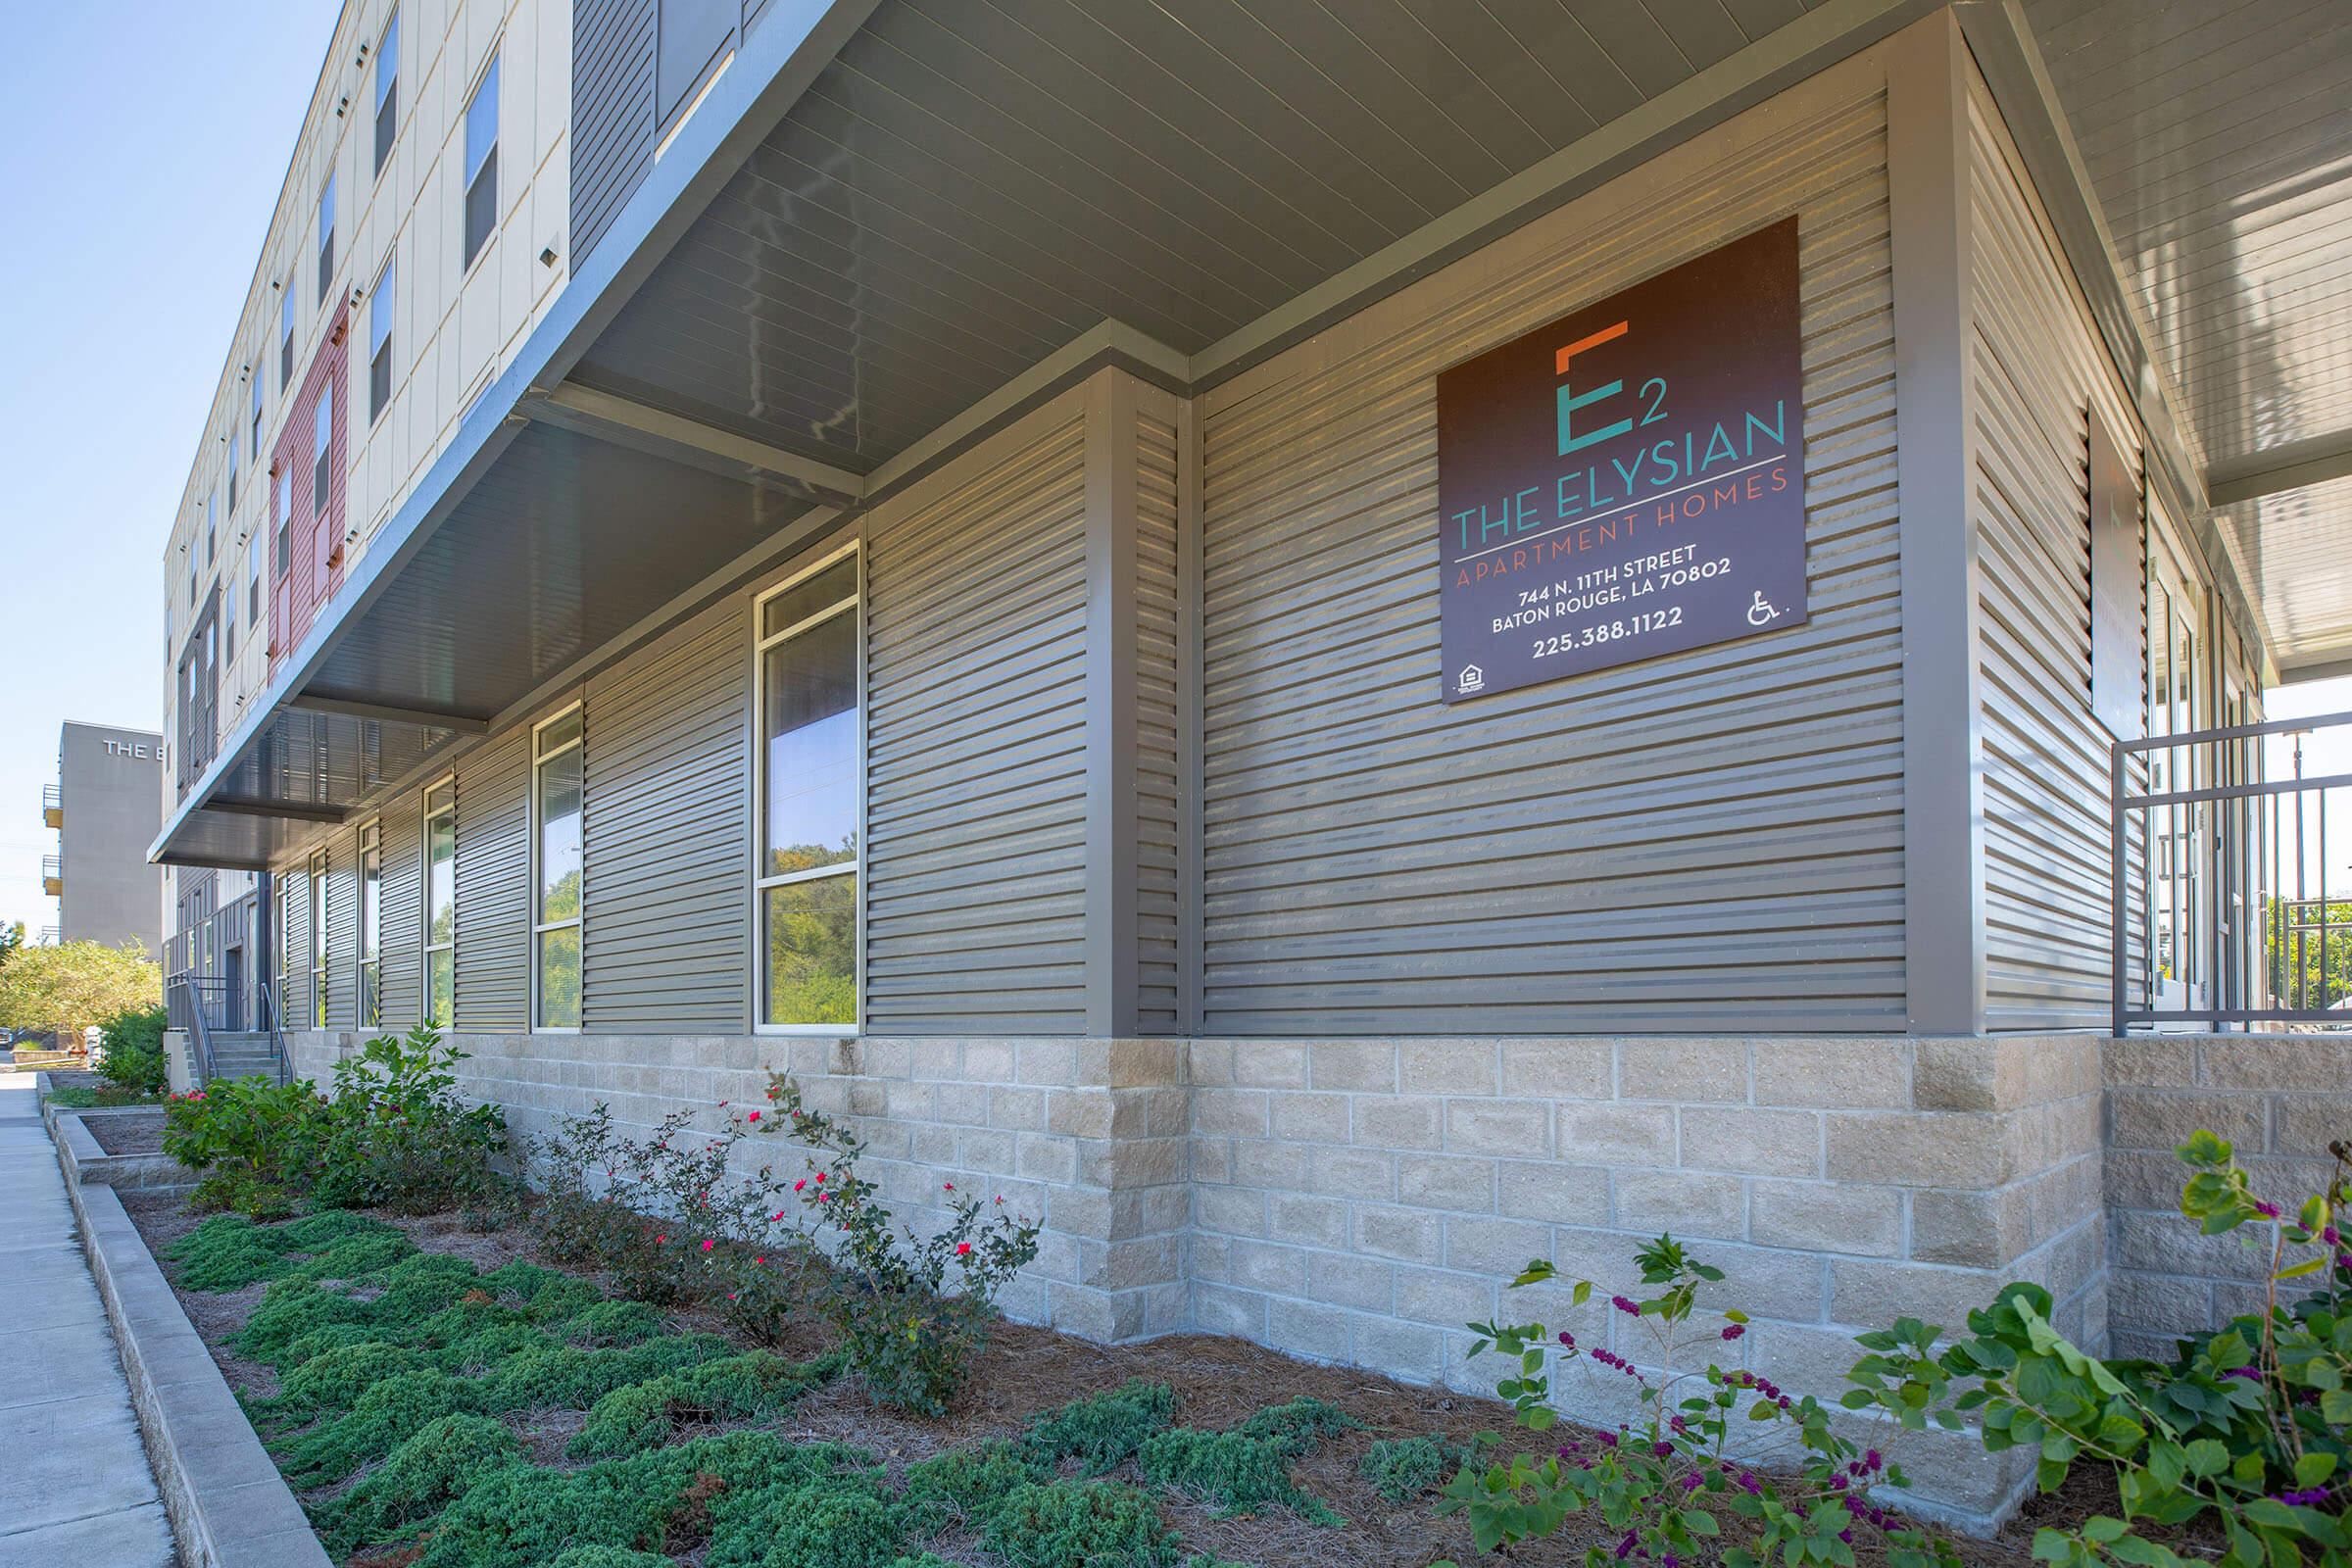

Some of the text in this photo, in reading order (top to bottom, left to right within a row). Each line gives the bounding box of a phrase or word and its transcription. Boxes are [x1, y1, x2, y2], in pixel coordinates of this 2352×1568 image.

[1451, 400, 1786, 550] THE ELYSIAN
[1456, 467, 1788, 588] APARTMENT HOMES
[1493, 558, 1732, 633] BATON ROUGE, LA 70802
[1519, 543, 1697, 607] 744 N. 11TH STREET
[1533, 606, 1684, 659] 225.388.1122
[102, 739, 148, 760] THE
